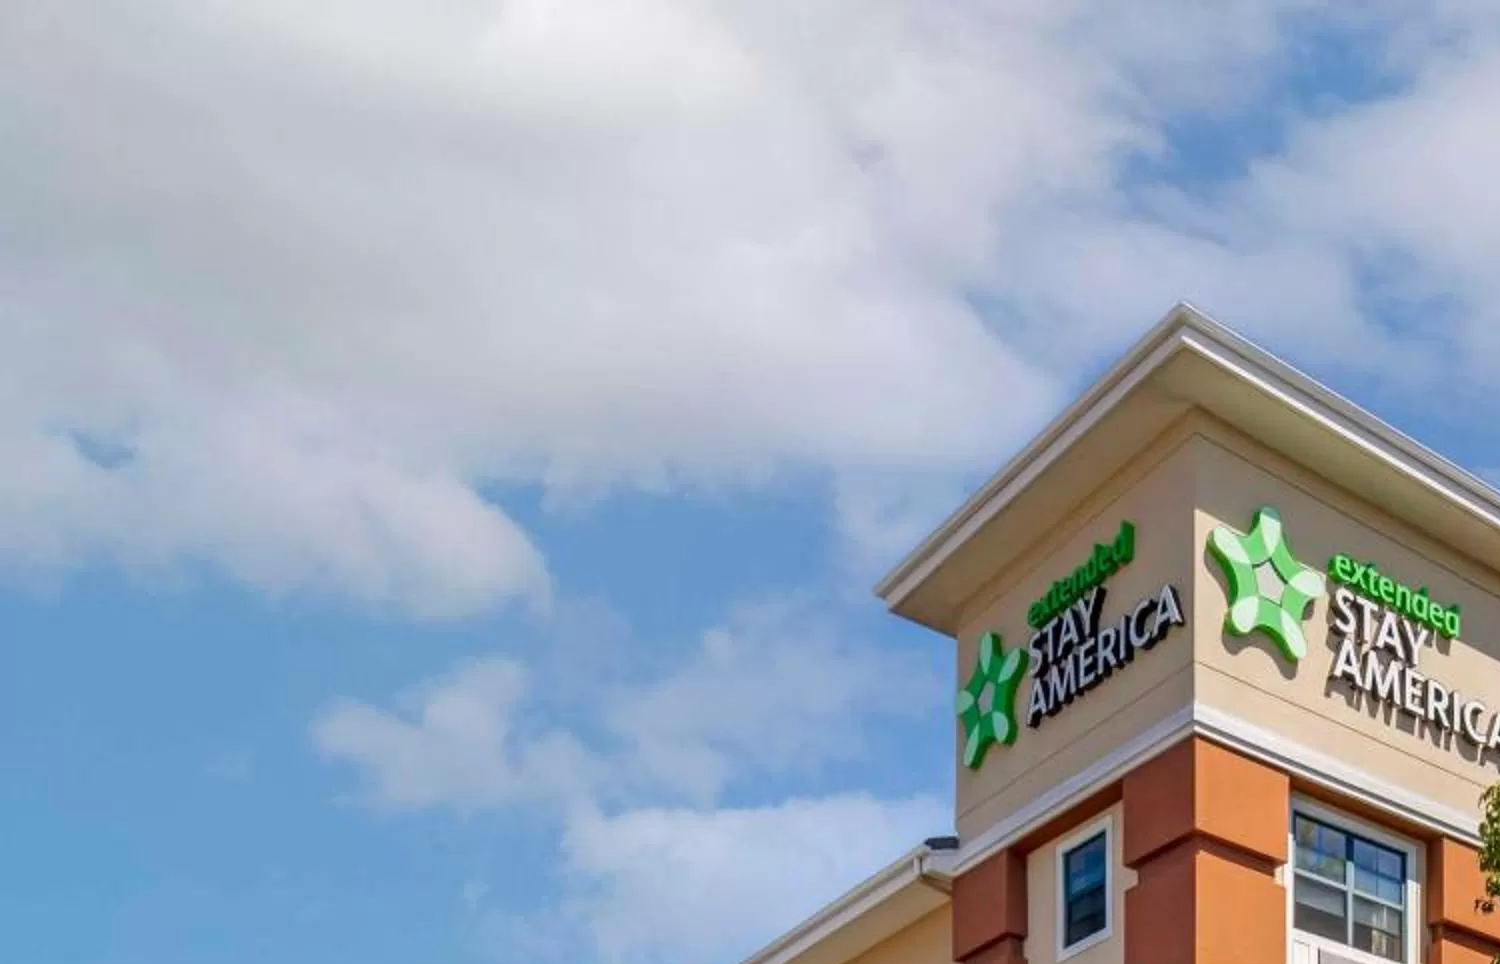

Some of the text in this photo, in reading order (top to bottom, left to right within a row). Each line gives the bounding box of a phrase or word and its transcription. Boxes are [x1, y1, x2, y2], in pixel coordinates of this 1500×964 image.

[1028, 520, 1135, 630] extended
[1328, 553, 1461, 639] extended
[1027, 584, 1185, 728] AMERICA
[1029, 586, 1105, 678] STAY
[1334, 586, 1428, 668] STAY
